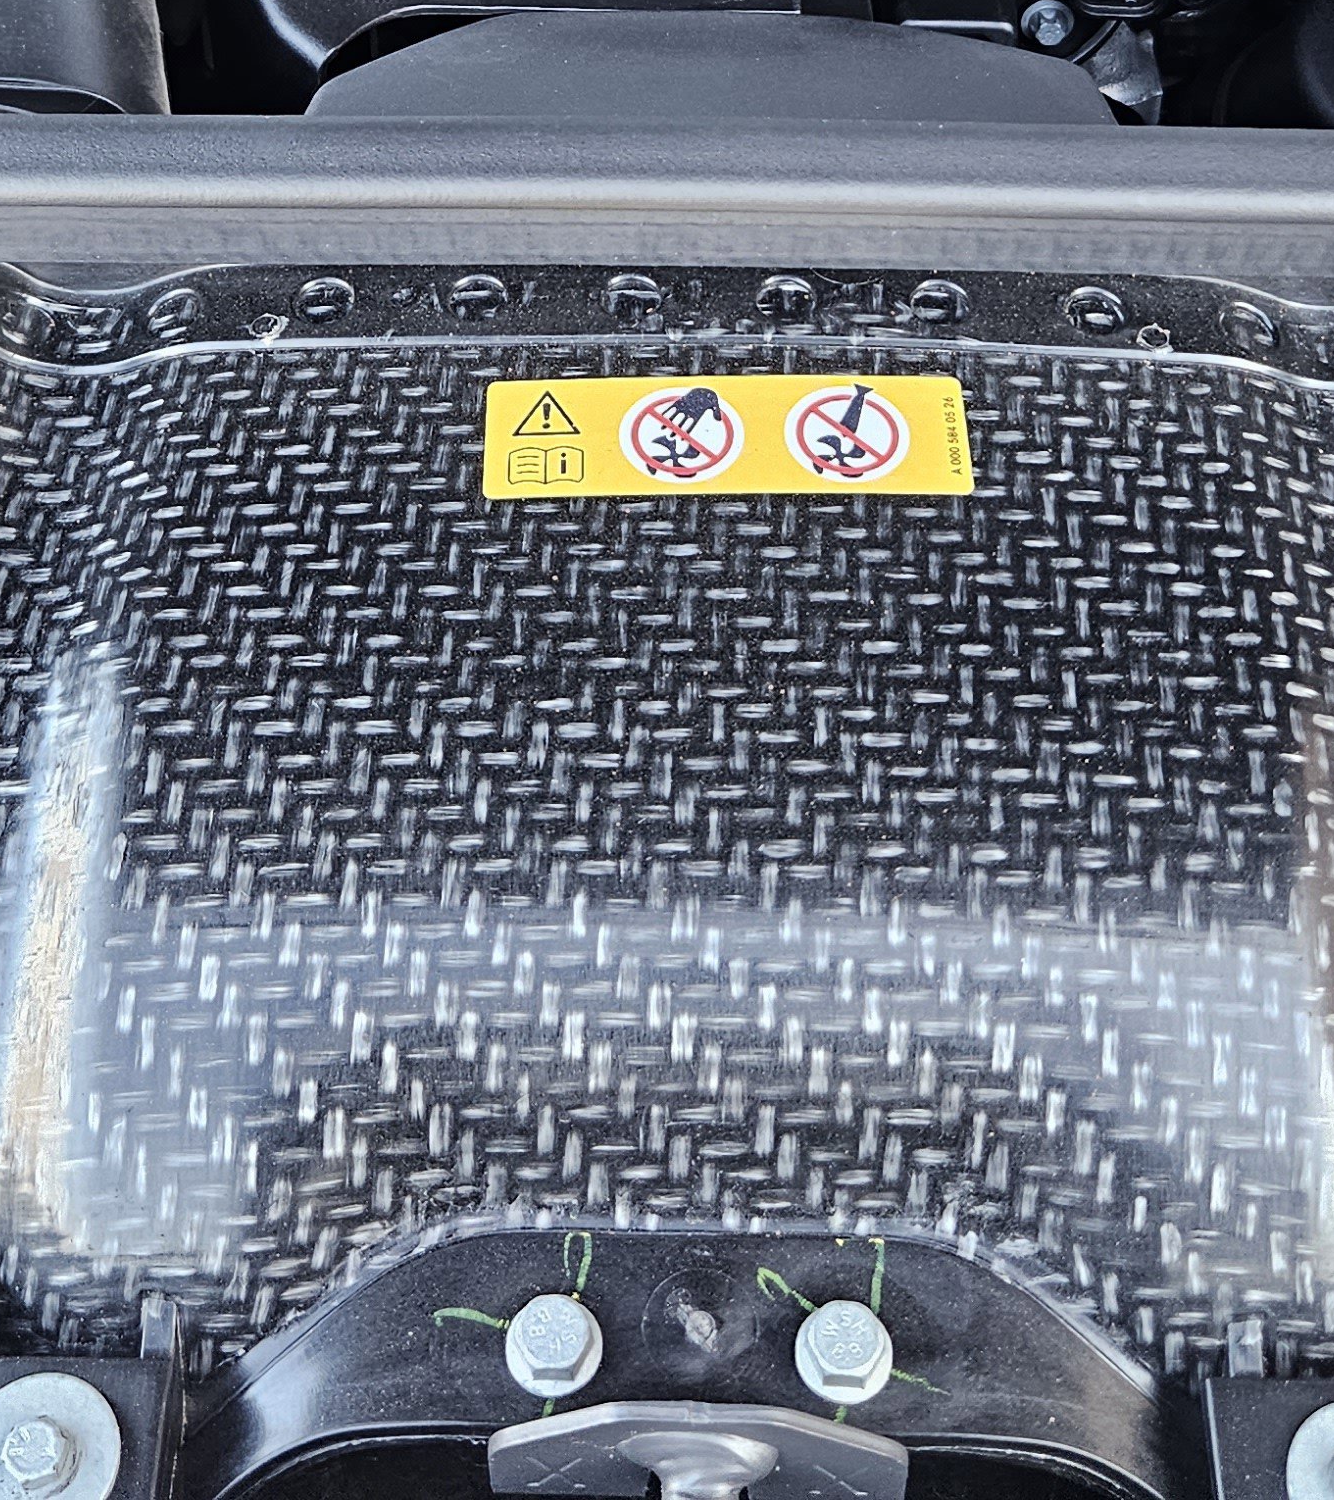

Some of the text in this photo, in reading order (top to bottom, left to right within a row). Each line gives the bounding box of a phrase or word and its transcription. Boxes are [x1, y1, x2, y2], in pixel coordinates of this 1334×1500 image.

[942, 396, 955, 409] 26
[944, 411, 956, 423] 05
[947, 426, 959, 444] 584
[948, 446, 962, 465] 000
